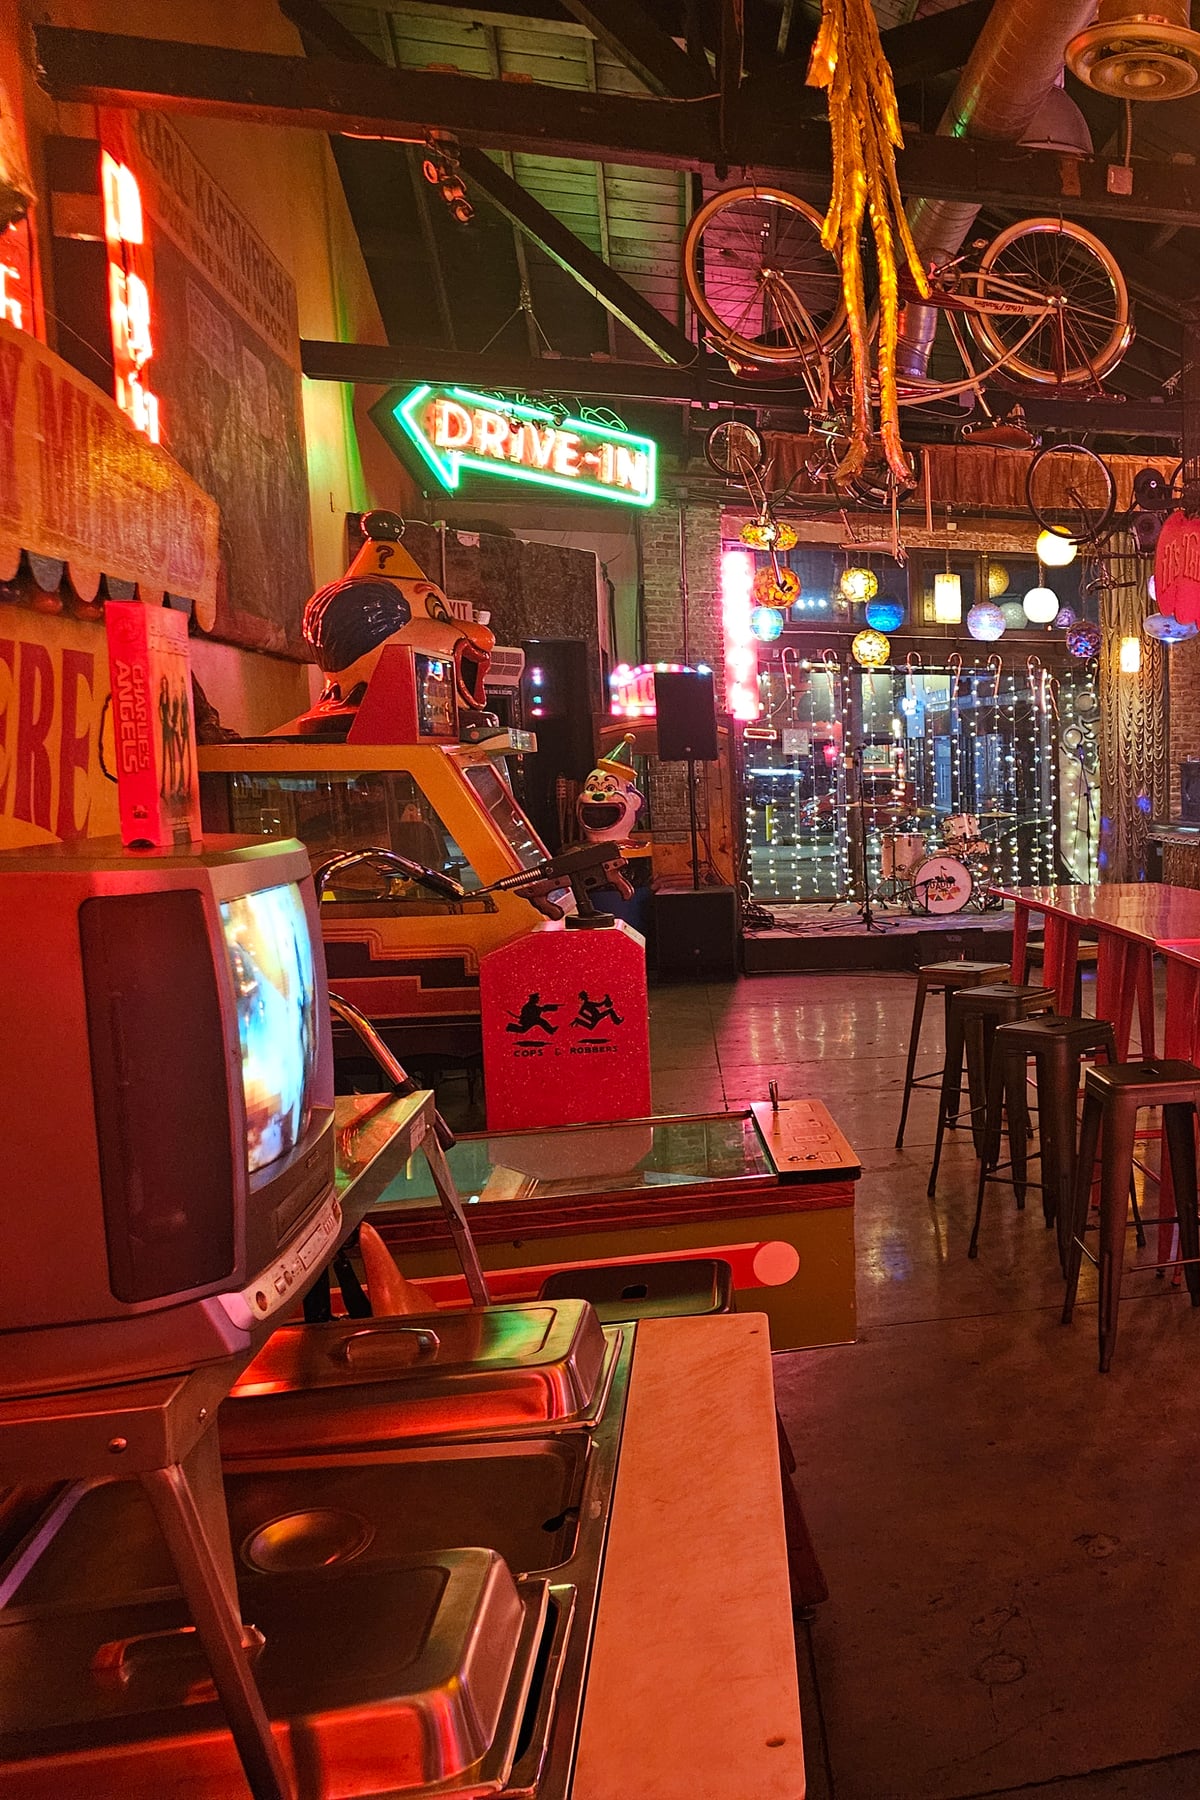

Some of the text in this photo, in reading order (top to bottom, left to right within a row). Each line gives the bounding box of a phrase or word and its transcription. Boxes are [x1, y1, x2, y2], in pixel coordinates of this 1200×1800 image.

[433, 397, 649, 494] DRIVE-IN
[449, 600, 469, 621] XIT
[115, 660, 140, 776] ANGELS
[131, 663, 151, 770] CHARLIE'S
[513, 1049, 543, 1057] COPS
[569, 1045, 618, 1055] ROBBERS
